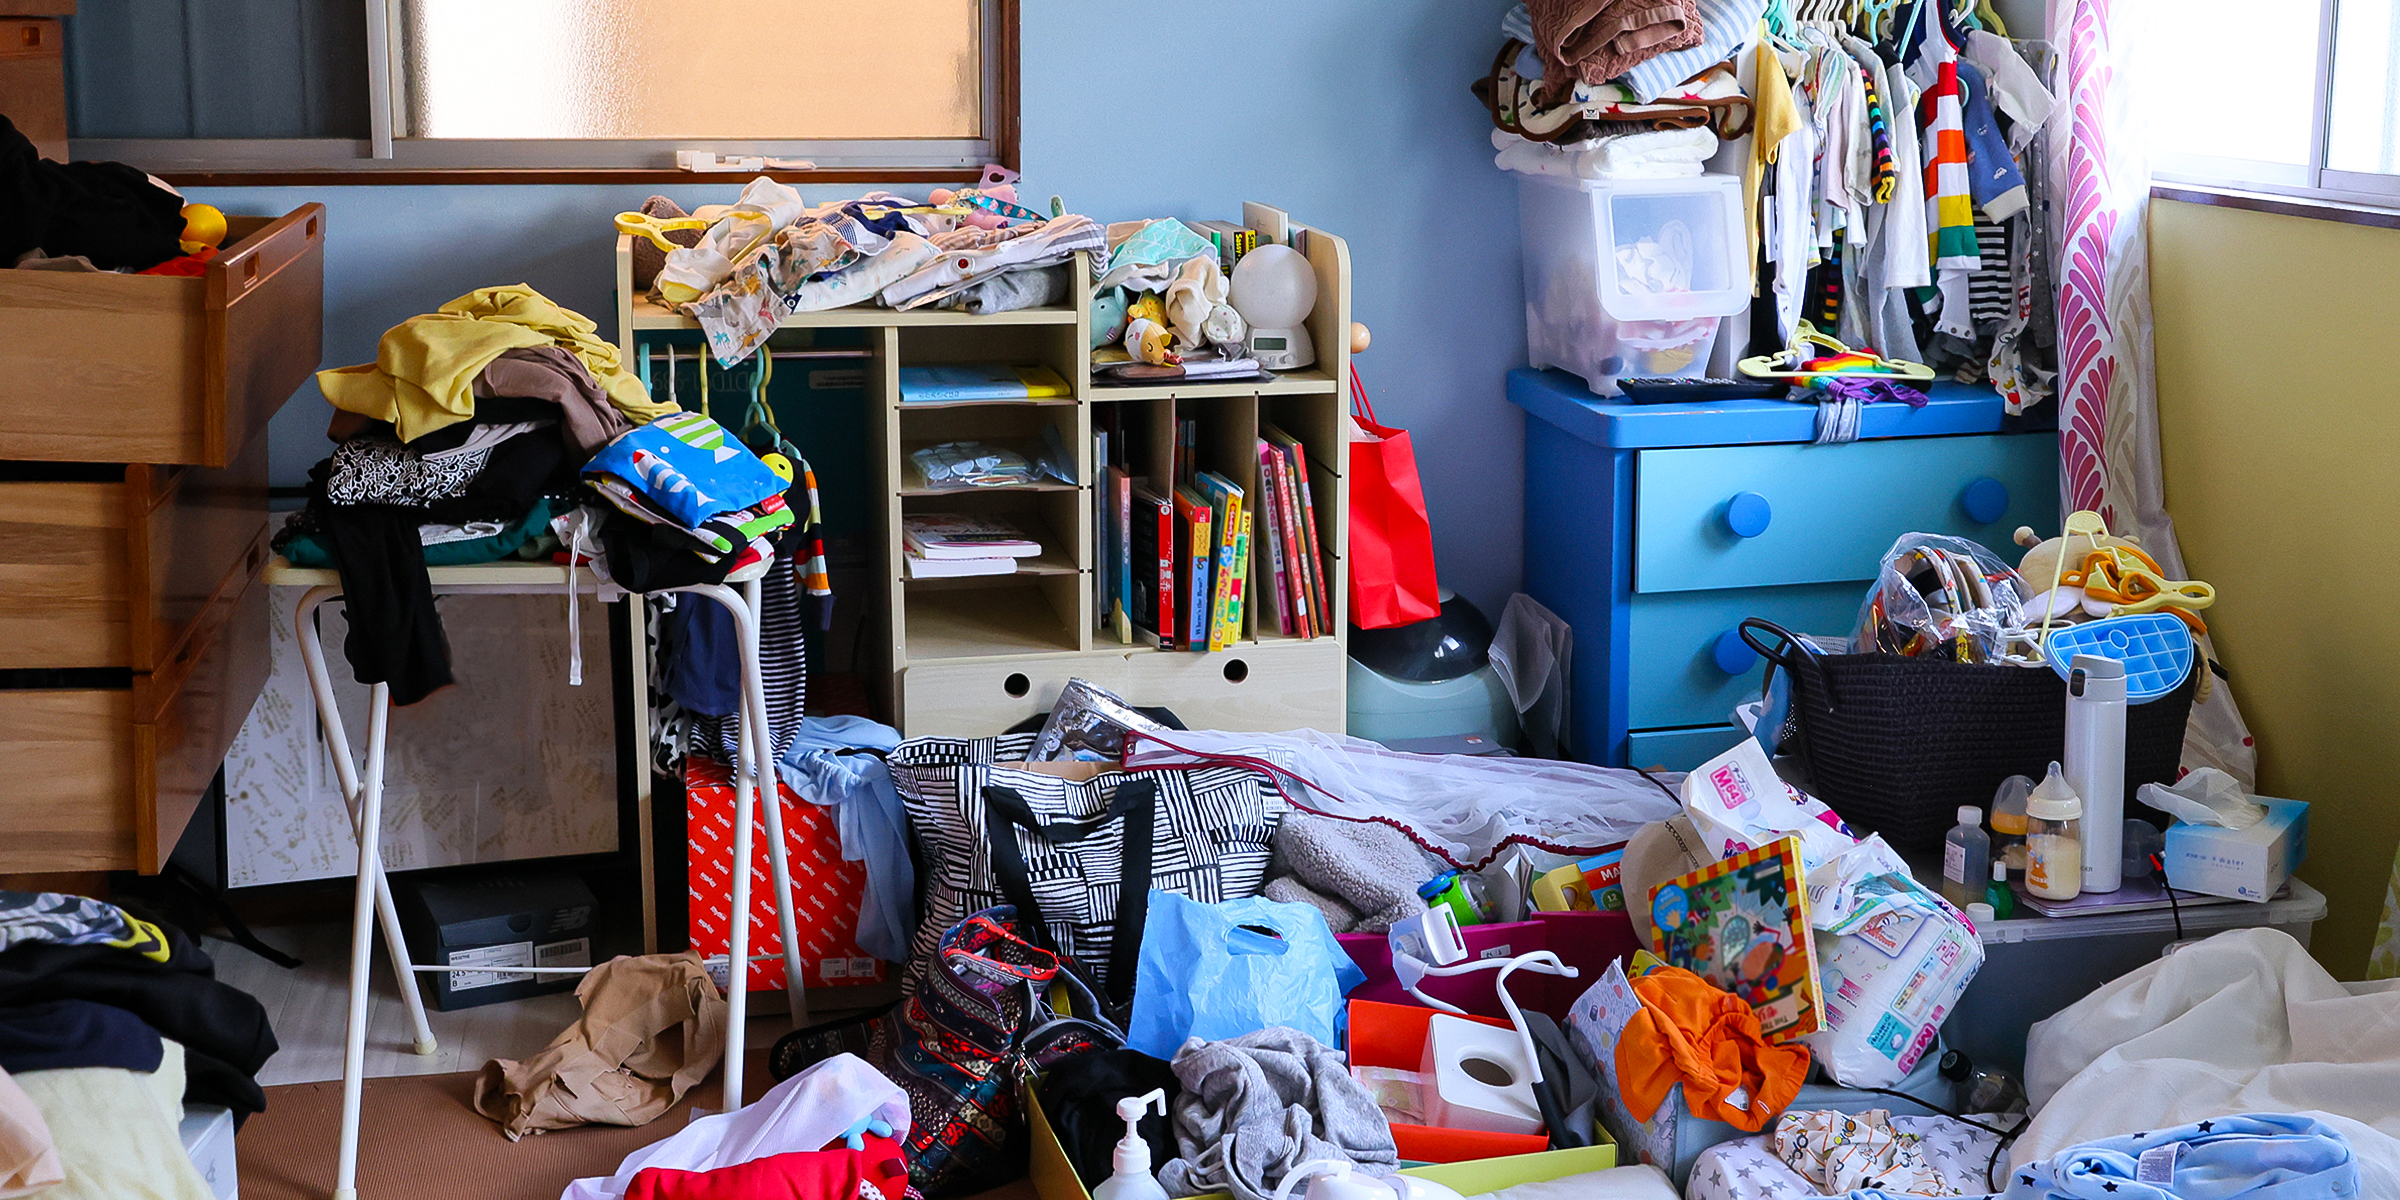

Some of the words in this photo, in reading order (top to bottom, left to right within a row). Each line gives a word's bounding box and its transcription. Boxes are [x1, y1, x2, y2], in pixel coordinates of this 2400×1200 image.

[1246, 233, 1256, 253] Sass
[1196, 577, 1204, 596] Bear?
[1600, 866, 1621, 881] MA
